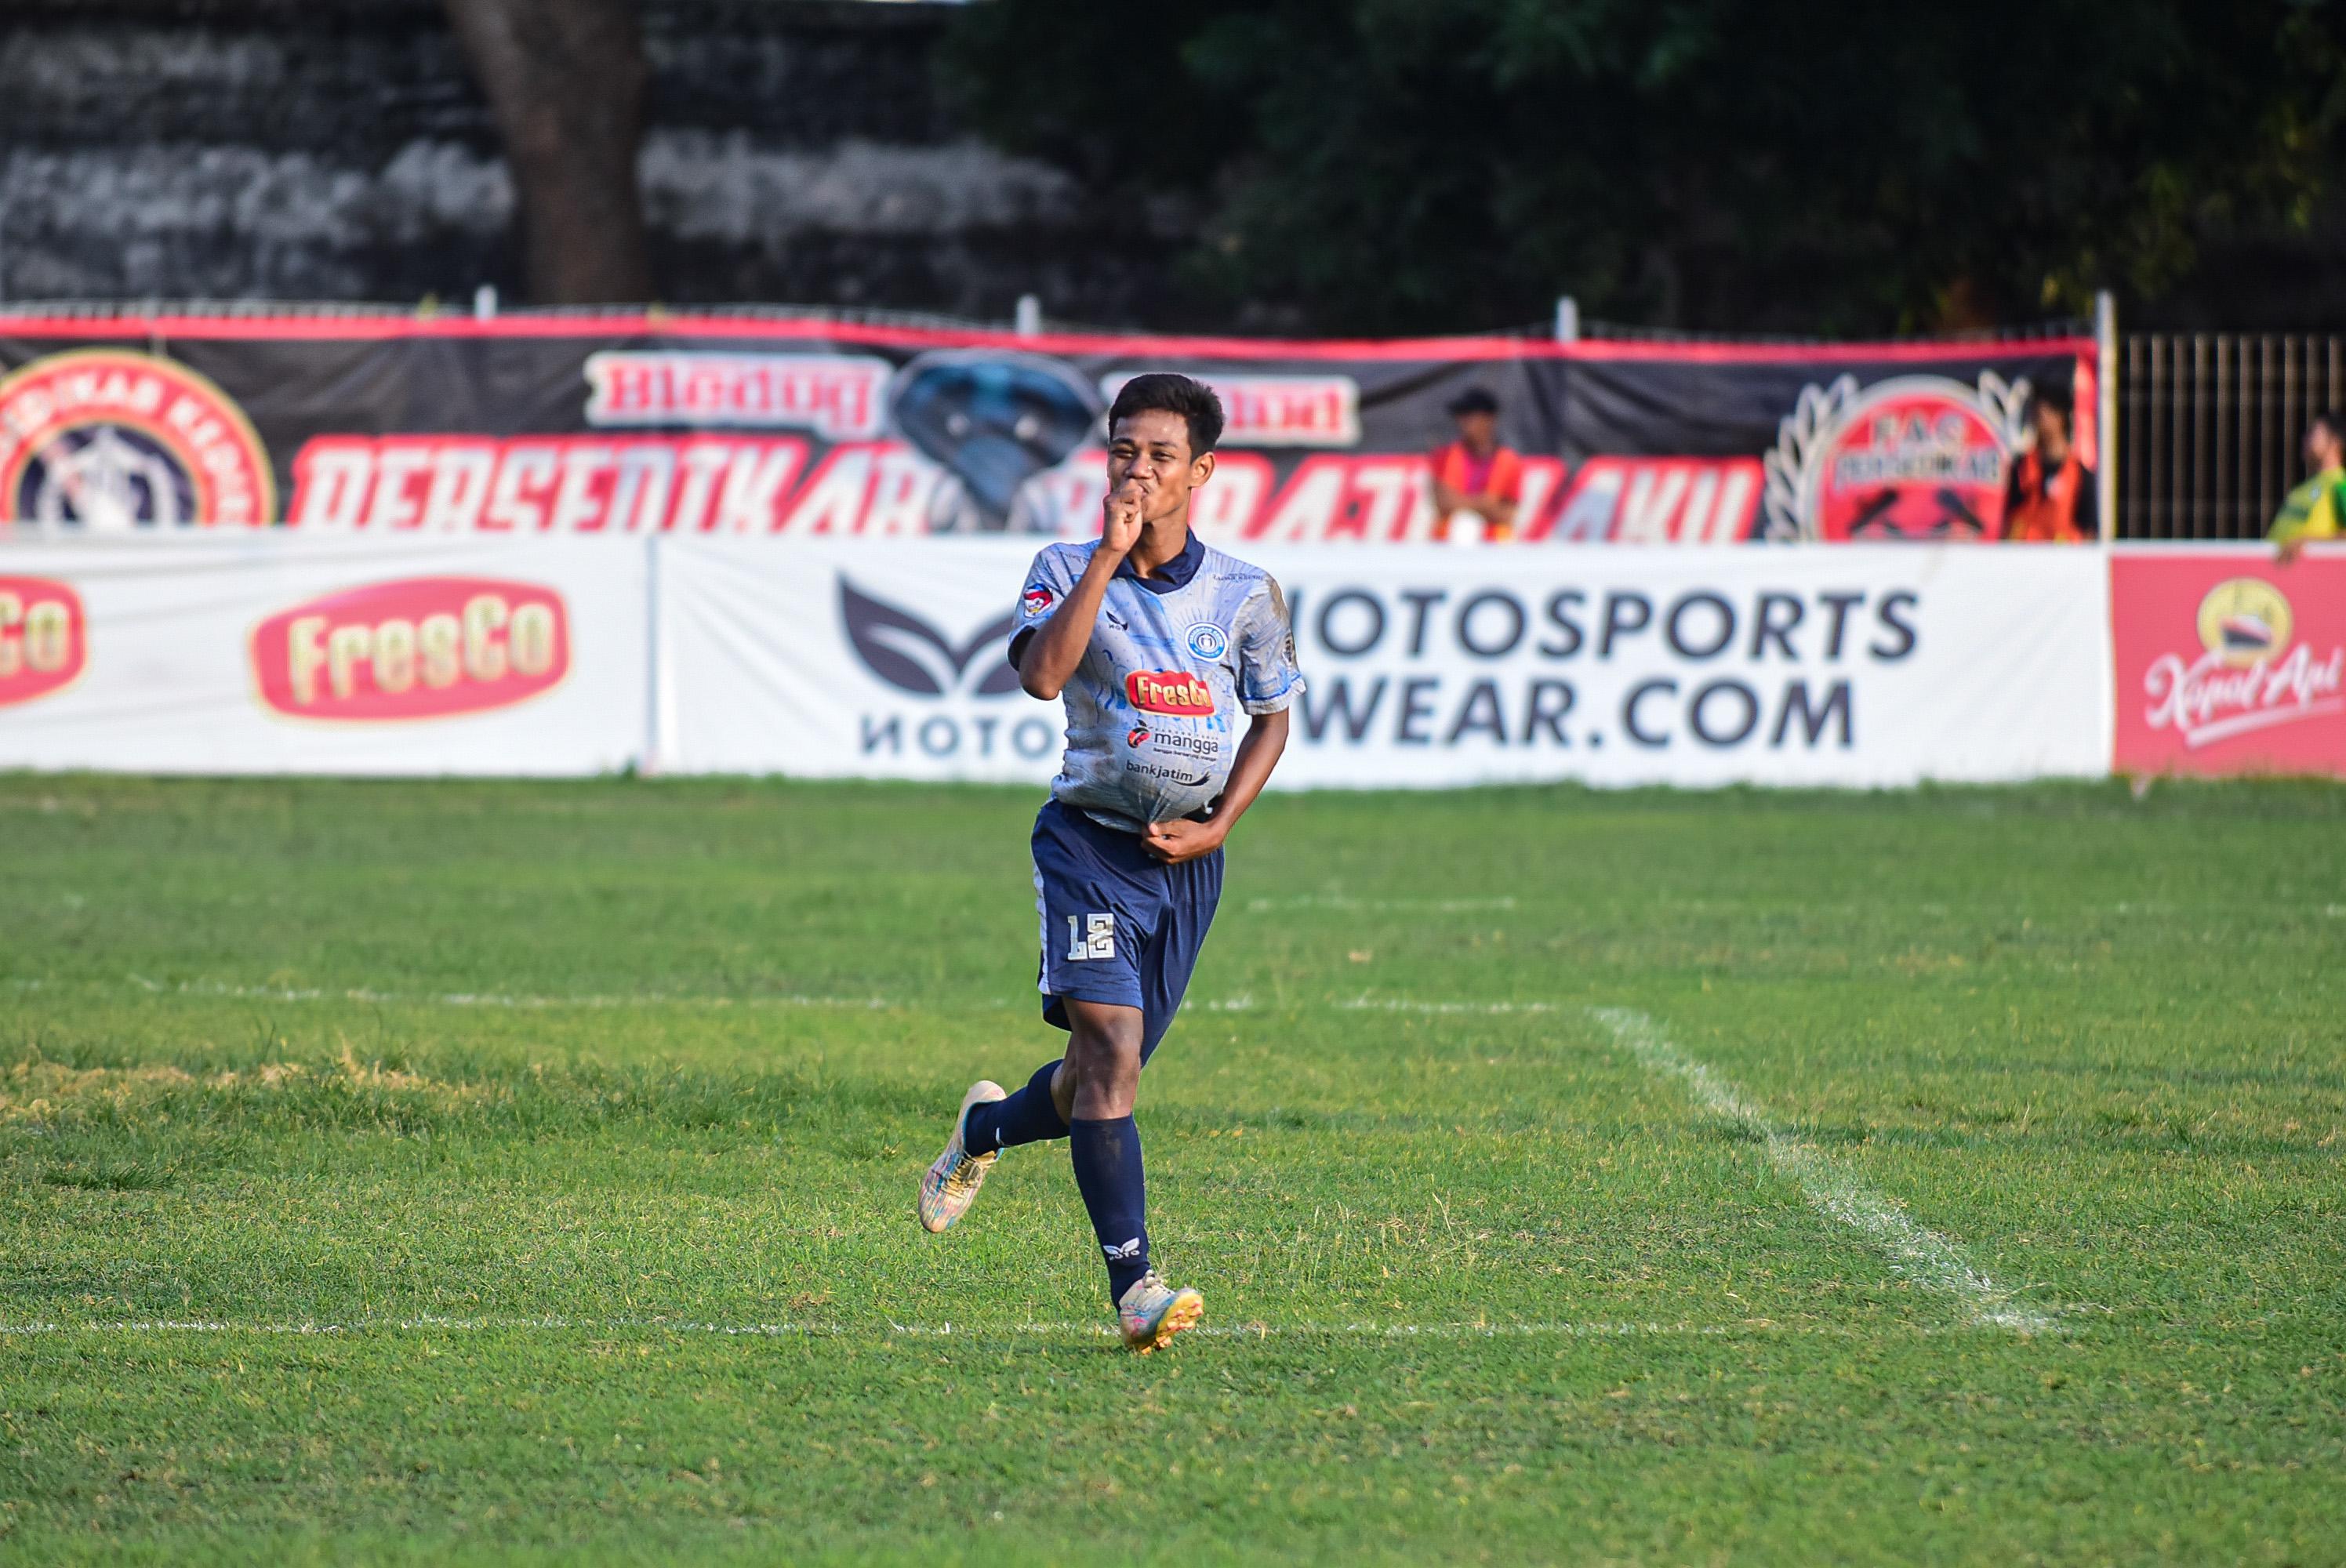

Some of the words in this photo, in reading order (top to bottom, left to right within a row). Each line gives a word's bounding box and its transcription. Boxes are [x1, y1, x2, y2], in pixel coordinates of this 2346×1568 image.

[1298, 674, 1854, 749] WEAR.COM
[1153, 732, 1219, 755] mangga
[1125, 759, 1193, 782] bankjatim
